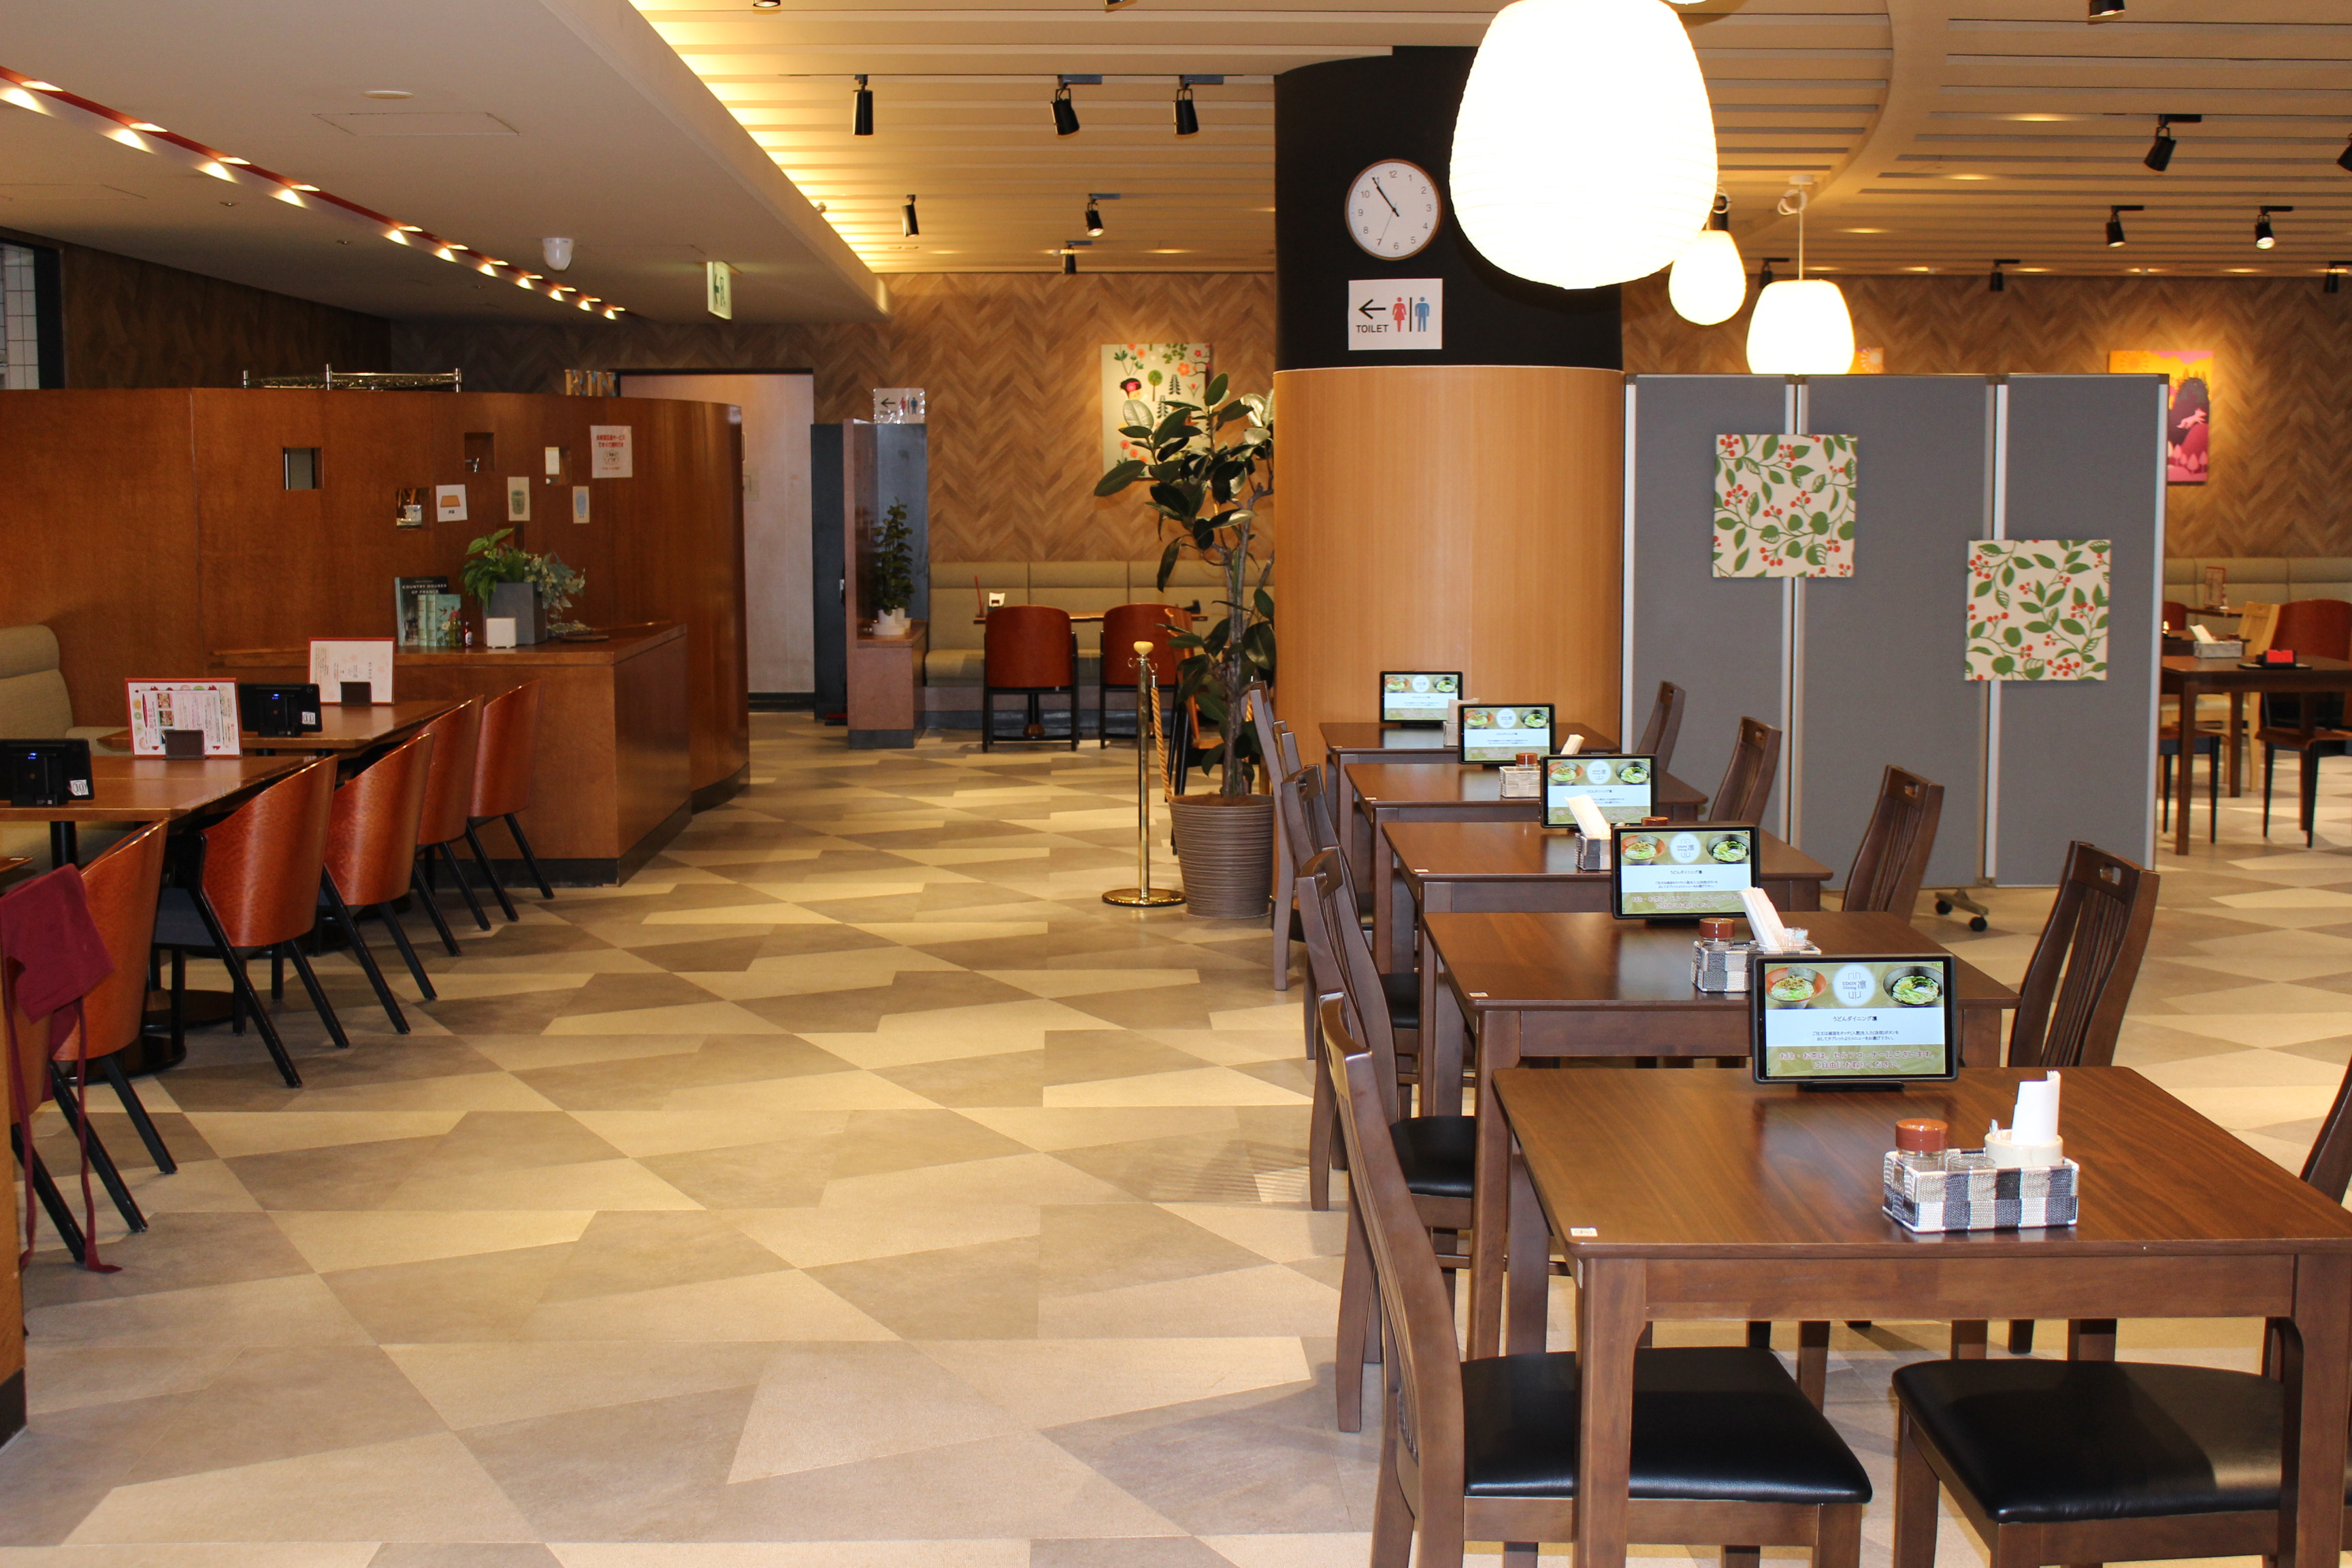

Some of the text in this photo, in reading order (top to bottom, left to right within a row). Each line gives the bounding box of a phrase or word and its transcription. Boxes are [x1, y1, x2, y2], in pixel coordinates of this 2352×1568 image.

[1389, 171, 1397, 179] 12
[1377, 238, 1382, 246] 7
[1356, 325, 1389, 333] TOILET
[564, 369, 617, 397] RIN
